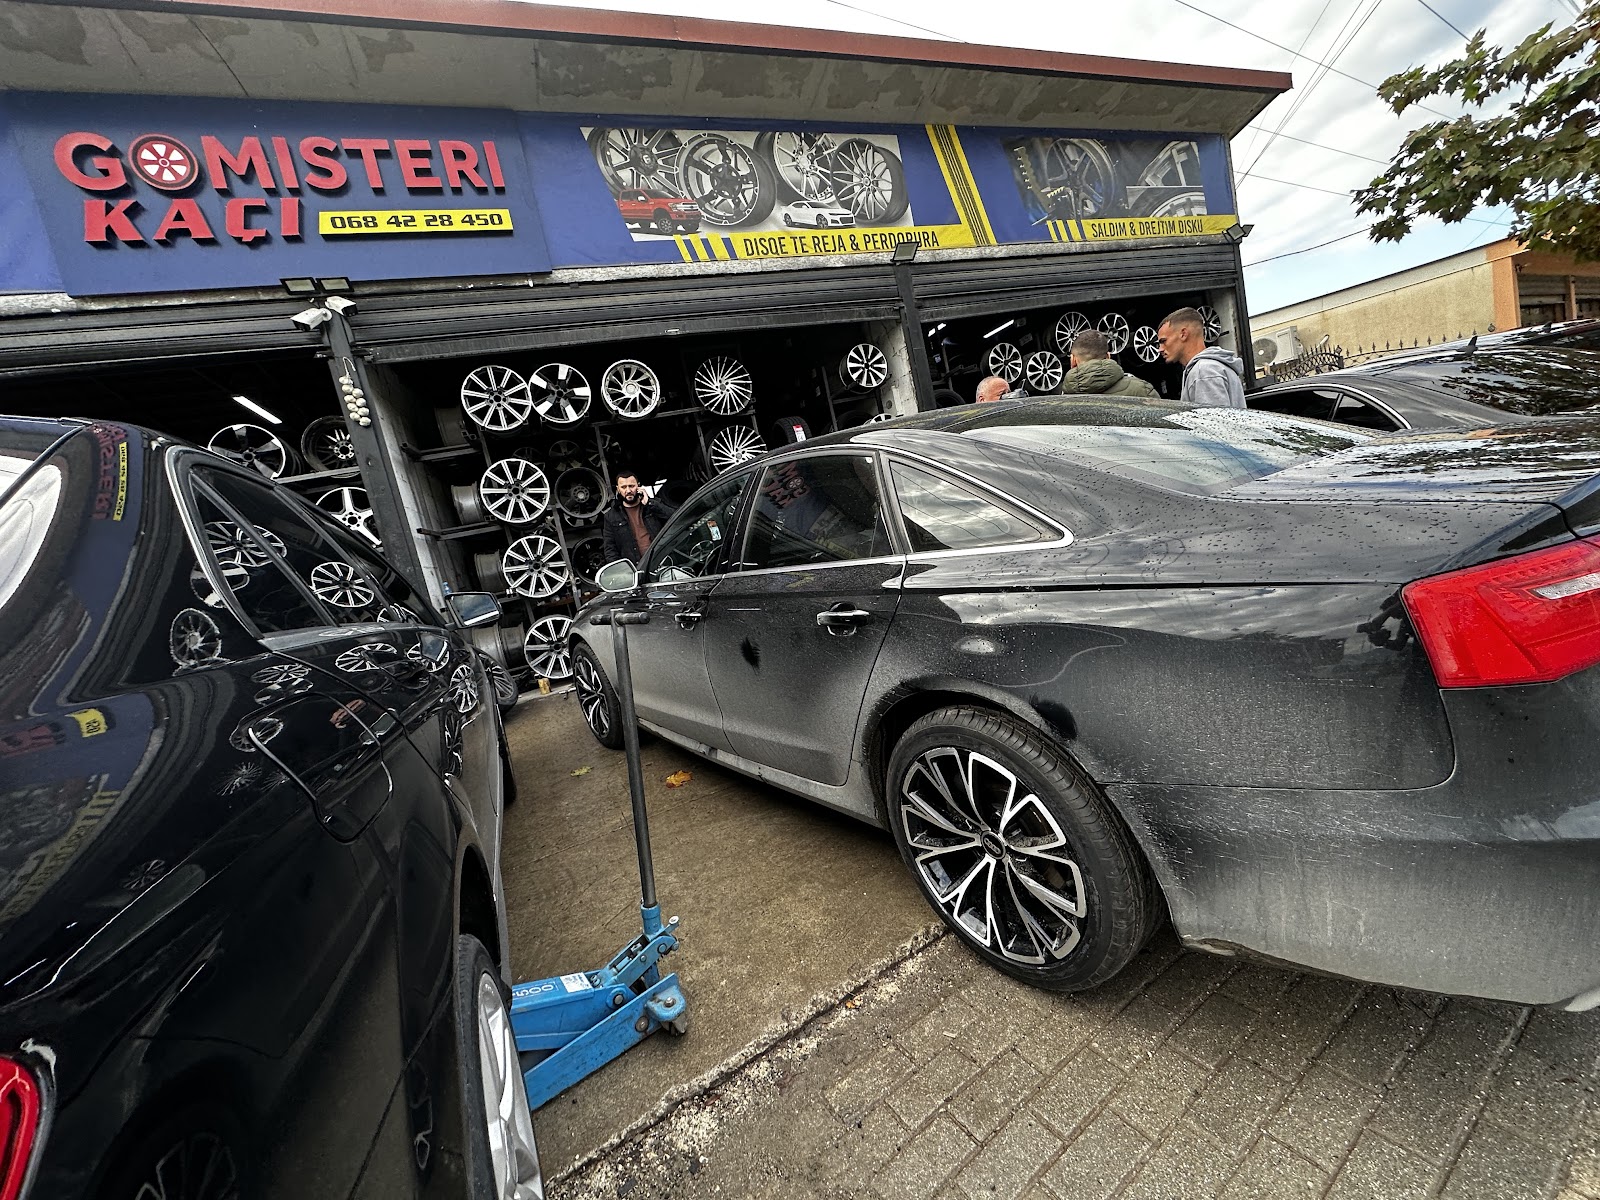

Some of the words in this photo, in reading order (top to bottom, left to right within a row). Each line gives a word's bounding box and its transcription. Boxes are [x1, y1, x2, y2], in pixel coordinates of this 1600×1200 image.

[85, 197, 300, 242] KAÇI
[330, 216, 379, 229] 068
[386, 215, 418, 228] 42
[424, 214, 453, 227] 28
[461, 213, 504, 226] 450
[1091, 222, 1127, 238] SALDIM
[1129, 221, 1137, 236] &
[1138, 219, 1177, 236] DREJTIM
[1178, 219, 1203, 234] DISKU
[790, 234, 810, 254] TE
[812, 233, 847, 253] REJA
[849, 233, 861, 251] &
